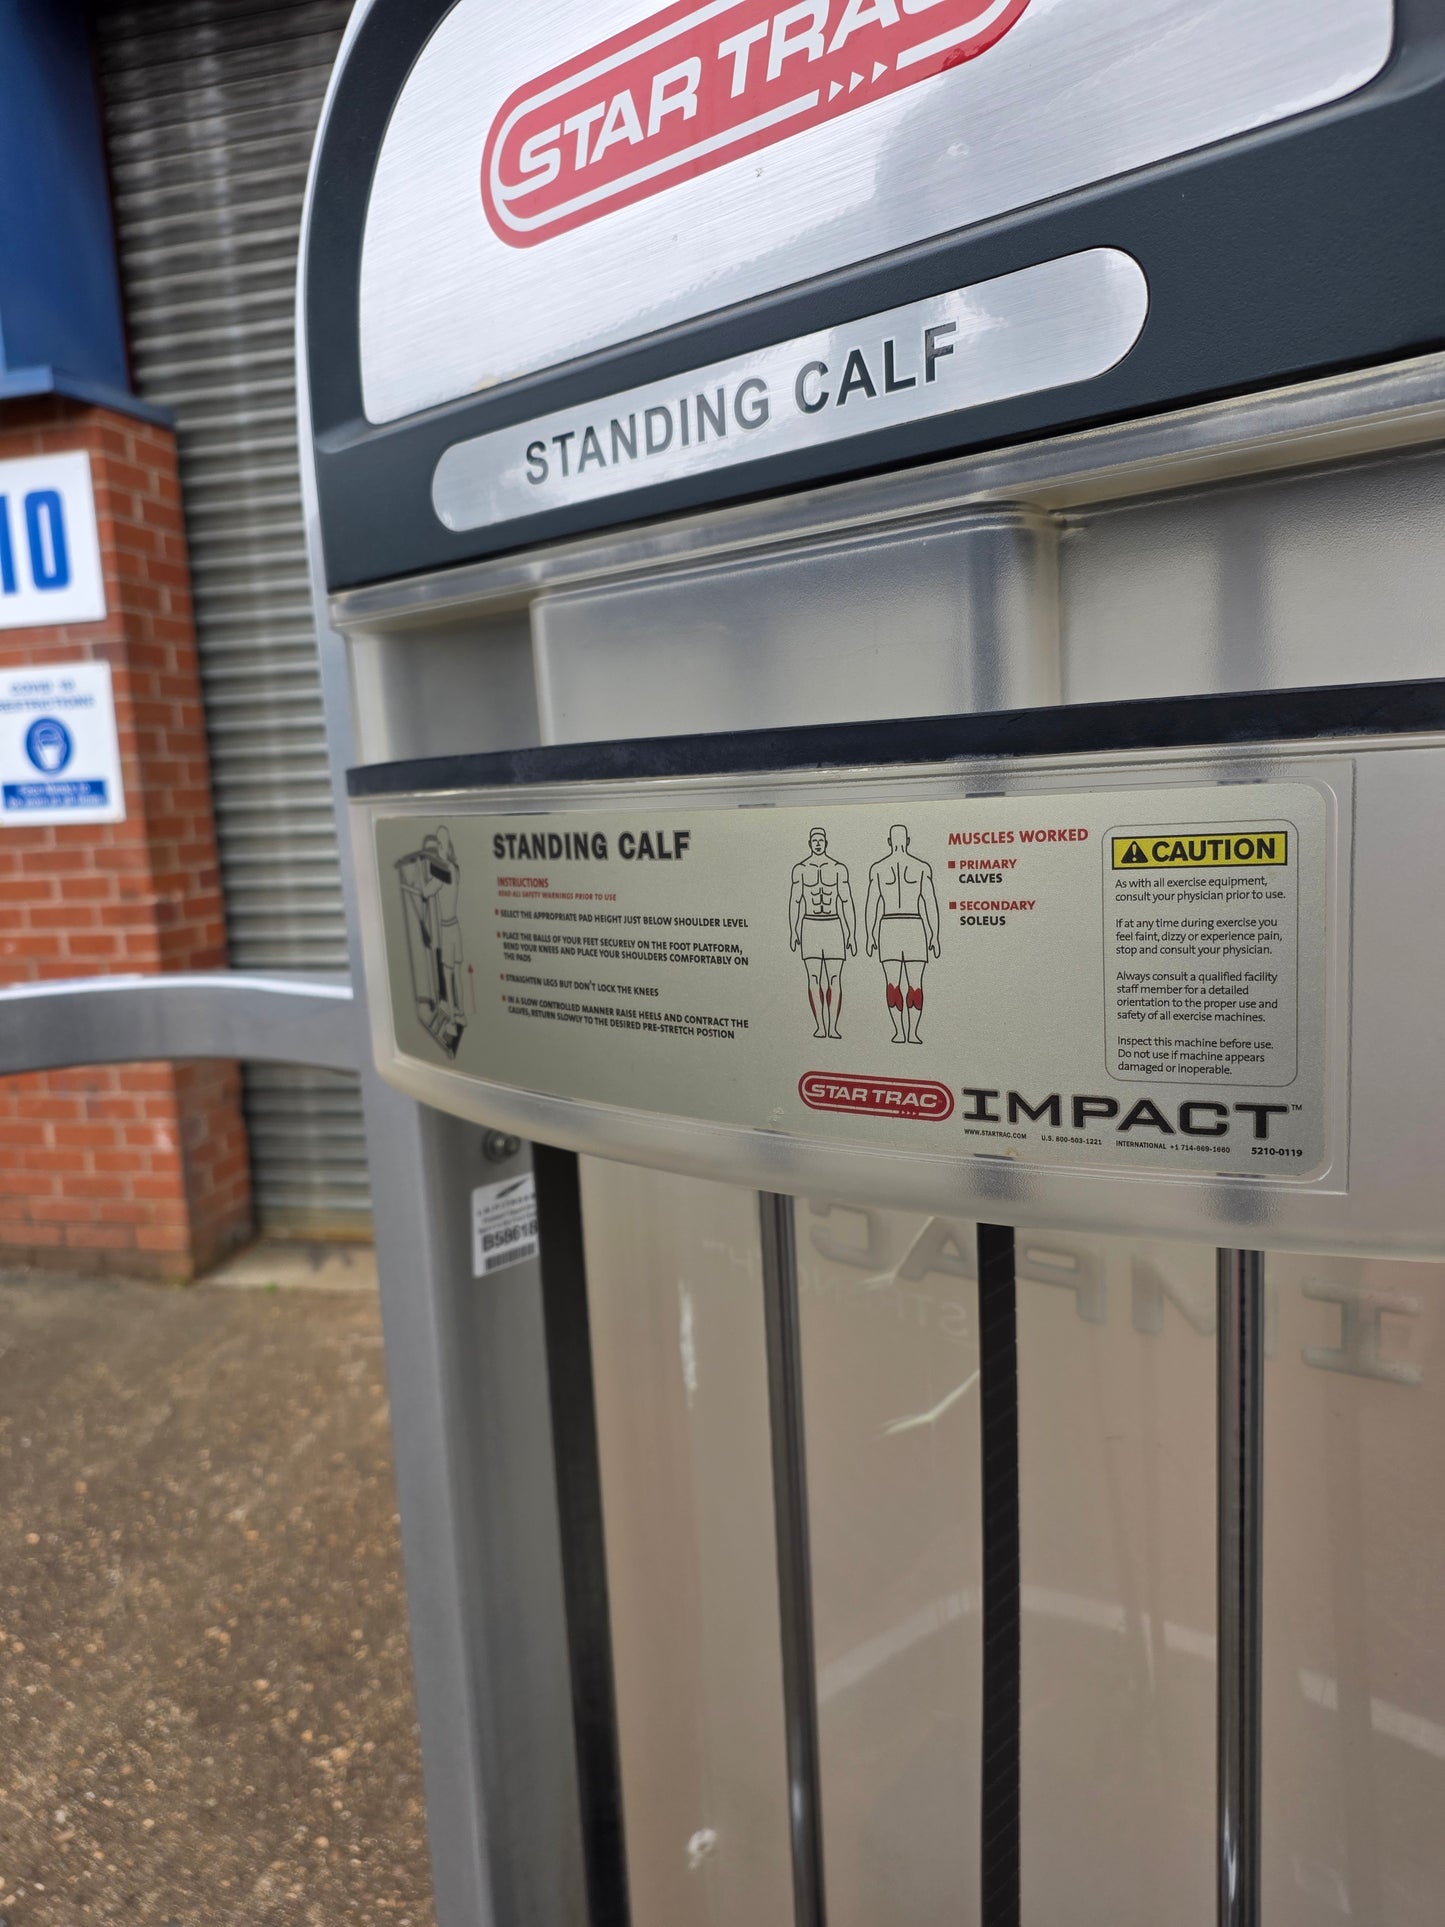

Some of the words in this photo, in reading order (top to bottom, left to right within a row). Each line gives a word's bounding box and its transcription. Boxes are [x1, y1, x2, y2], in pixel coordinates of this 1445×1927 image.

[517, 54, 703, 183] STAR
[525, 376, 770, 485] STANDING
[794, 321, 958, 414] CALF
[948, 831, 1015, 845] MUSCLES
[1019, 828, 1089, 843] WORKED
[493, 831, 608, 860] STANDING
[618, 830, 690, 860] CALF
[1151, 838, 1275, 862] CAUTION
[959, 859, 1017, 869] PRIMARY
[497, 877, 549, 888] INSTRUCTIONS
[958, 873, 1003, 884] CALVES
[1115, 879, 1127, 889] As
[1129, 878, 1151, 888] with
[1153, 877, 1165, 888] all
[1167, 878, 1206, 888] exercise
[1208, 876, 1268, 890] equipment,
[542, 892, 573, 900] WARNINGS
[1115, 891, 1151, 902] consult
[1152, 893, 1175, 904] your
[1177, 890, 1223, 903] physician
[1226, 890, 1250, 902] prior
[1252, 891, 1264, 899] to
[1266, 891, 1286, 899] use.
[959, 900, 1036, 910] SECONDARY
[501, 909, 519, 918] SELECT
[520, 910, 532, 919] THE
[533, 911, 577, 922] APPROPRIATE
[579, 914, 593, 922] PAD
[595, 914, 622, 924] HEIGHT
[624, 916, 641, 925] JUST
[643, 916, 672, 926] BELOW
[674, 917, 720, 927] SHOULDER
[723, 918, 748, 928] LEVEL
[960, 916, 1006, 926] SOLEUS
[1125, 920, 1134, 928] at
[1136, 920, 1154, 930] any
[1156, 918, 1180, 928] time
[1181, 918, 1214, 930] during
[1216, 918, 1257, 927] exercise
[1259, 918, 1278, 929] you
[502, 932, 519, 940] PLACE
[520, 932, 532, 941] THE
[533, 934, 551, 943] BALLS
[553, 935, 562, 943] OF
[562, 936, 581, 945] YOUR
[583, 937, 598, 946] FEET
[600, 938, 636, 949] SECURELY
[637, 940, 649, 949] ON
[652, 941, 667, 950] THE
[669, 942, 691, 951] FOOT
[693, 942, 743, 955] PLATFORM,
[1115, 931, 1133, 941] feel
[1135, 931, 1160, 943] faint,
[1161, 932, 1186, 943] dizzy
[1188, 933, 1198, 942] or
[1200, 932, 1256, 944] experience
[1257, 932, 1282, 944] pain,
[503, 942, 519, 951] BEND
[521, 943, 537, 952] YOUR
[538, 944, 559, 954] KNEES
[561, 946, 576, 955] AND
[577, 947, 598, 957] PLACE
[599, 949, 620, 959] YOUR
[621, 951, 667, 962] SHOULDERS
[669, 953, 731, 965] COMFORTABLY
[734, 956, 749, 966] ON
[504, 952, 515, 961] THE
[516, 953, 531, 962] PADS
[1116, 946, 1137, 957] stop
[1139, 945, 1158, 954] and
[1160, 944, 1196, 954] consult
[1197, 946, 1221, 957] your
[1223, 944, 1272, 957] physician.
[1116, 972, 1151, 983] Always
[1152, 972, 1188, 981] consult
[1198, 972, 1242, 984] qualified
[1244, 972, 1278, 984] facility
[506, 974, 542, 986] STRAIGHTEN
[543, 978, 558, 987] LEGS
[560, 980, 572, 989] BUT
[574, 980, 596, 991] DON'T
[597, 984, 616, 993] LOCK
[617, 985, 632, 995] THE
[634, 987, 659, 997] KNEES
[1116, 984, 1139, 994] staff
[1140, 985, 1183, 995] member
[1184, 984, 1198, 995] for
[1200, 987, 1206, 995] a
[1208, 985, 1249, 996] detailed
[1116, 998, 1170, 1008] orientation
[1172, 999, 1183, 1008] to
[1184, 998, 1202, 1008] the
[1204, 1000, 1237, 1011] proper
[1238, 1001, 1257, 1009] use
[1259, 999, 1278, 1009] and
[521, 997, 539, 1007] SLOW
[540, 1000, 581, 1012] CONTROLLED
[582, 1005, 614, 1016] MANNER
[616, 1008, 637, 1019] RAISE
[639, 1010, 662, 1021] HEELS
[664, 1013, 683, 1023] AND
[684, 1015, 729, 1027] CONTRACT
[731, 1018, 749, 1028] THE
[1117, 1010, 1146, 1023] safety
[1147, 1010, 1160, 1020] of
[1160, 1011, 1171, 1021] all
[1173, 1011, 1213, 1021] exercise
[1214, 1012, 1266, 1022] machines.
[532, 1009, 556, 1020] RETURN
[557, 1012, 583, 1024] SLOWLY
[584, 1016, 593, 1025] TO
[594, 1017, 608, 1026] THE
[610, 1019, 641, 1030] DESIRED
[643, 1022, 694, 1036] PRE-STRETCH
[696, 1028, 735, 1039] POSTION
[1117, 1037, 1152, 1048] Inspect
[1154, 1037, 1173, 1047] this
[1174, 1037, 1218, 1048] machine
[1219, 1038, 1251, 1048] before
[1253, 1041, 1274, 1049] use.
[1118, 1049, 1132, 1058] Do
[1134, 1051, 1150, 1059] not
[1171, 1051, 1178, 1060] if
[1179, 1051, 1223, 1061] machine
[1225, 1054, 1264, 1064] appears
[1118, 1062, 1164, 1074] damaged
[1165, 1064, 1176, 1073] or
[1178, 1064, 1233, 1076] inoperable.
[810, 1084, 868, 1102] STAR
[872, 1090, 938, 1108] TRAC
[961, 1087, 1290, 1140] IMPACT
[964, 1128, 1027, 1140] WWW.STARTRAC.COM
[1115, 1140, 1166, 1150] INTERNATIONAL
[1251, 1147, 1303, 1157] 5210-0119
